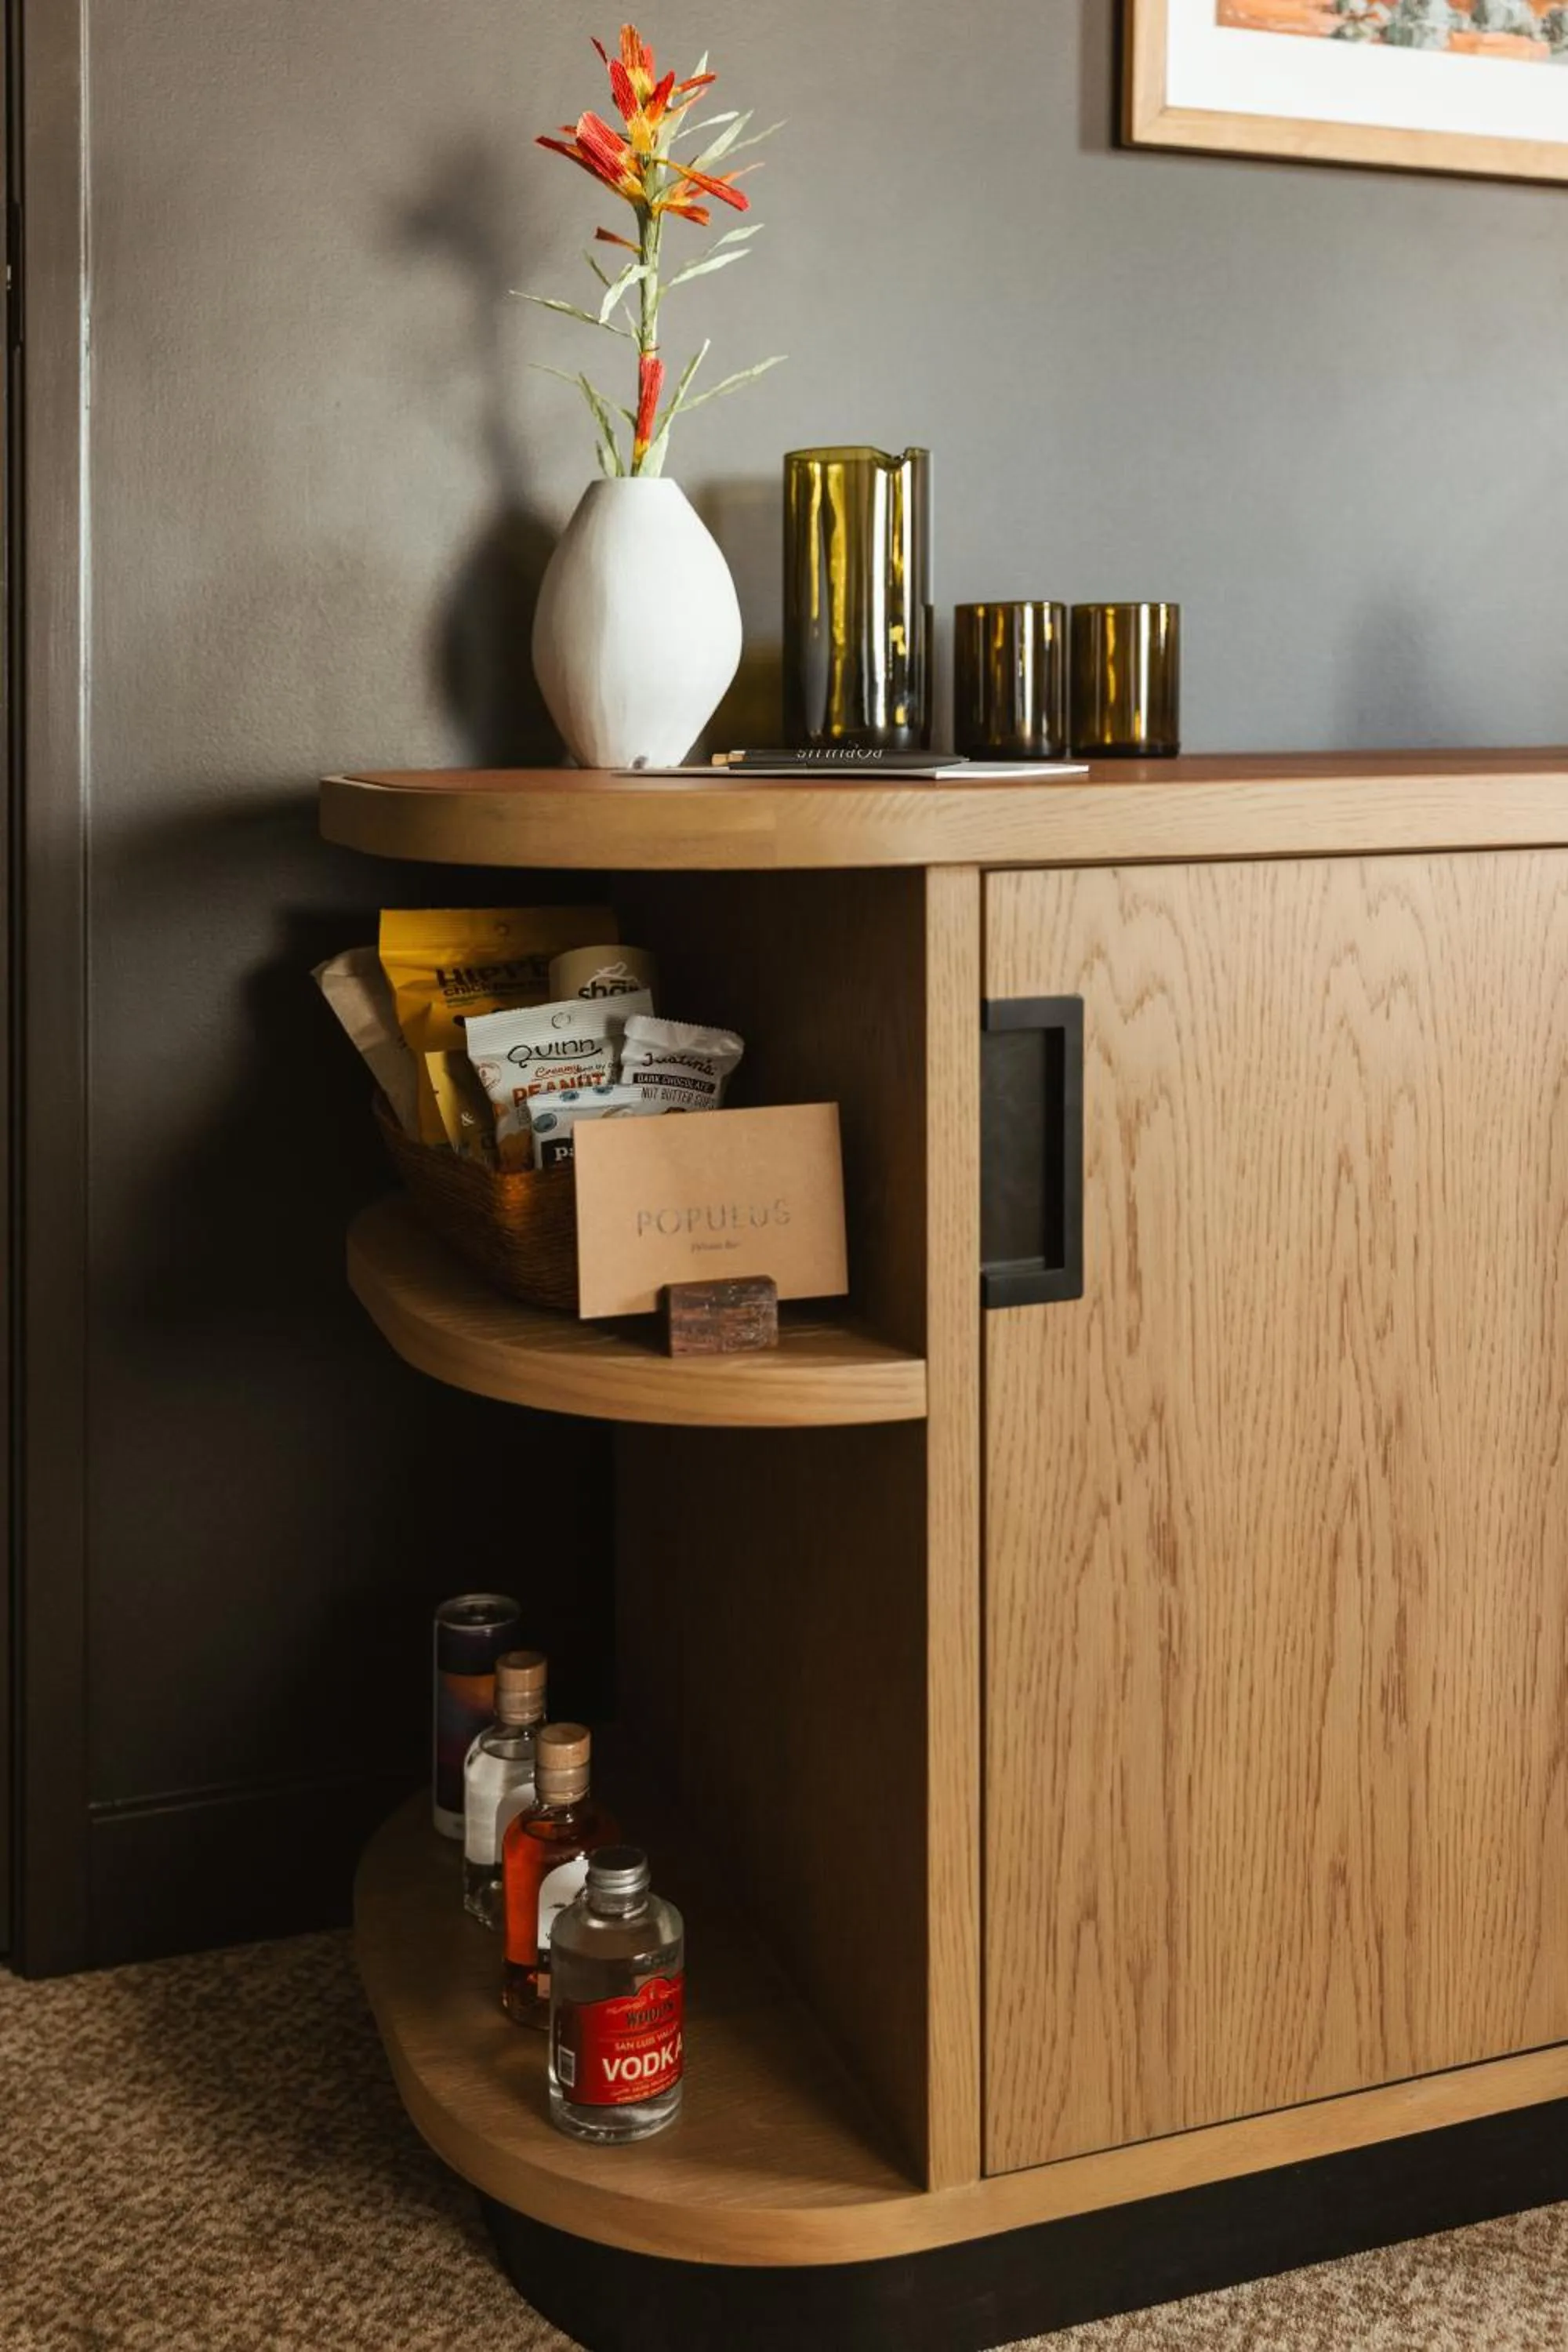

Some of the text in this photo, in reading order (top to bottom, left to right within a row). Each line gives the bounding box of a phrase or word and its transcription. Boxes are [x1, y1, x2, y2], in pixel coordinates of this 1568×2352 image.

[512, 1072, 606, 1108] PEANUT
[637, 1072, 714, 1093] DARK CHOCOLATE
[641, 1087, 659, 1099] NUT
[661, 1087, 694, 1105] BUTTER
[637, 1198, 792, 1237] POPULUS
[601, 2032, 683, 2082] VODKA
